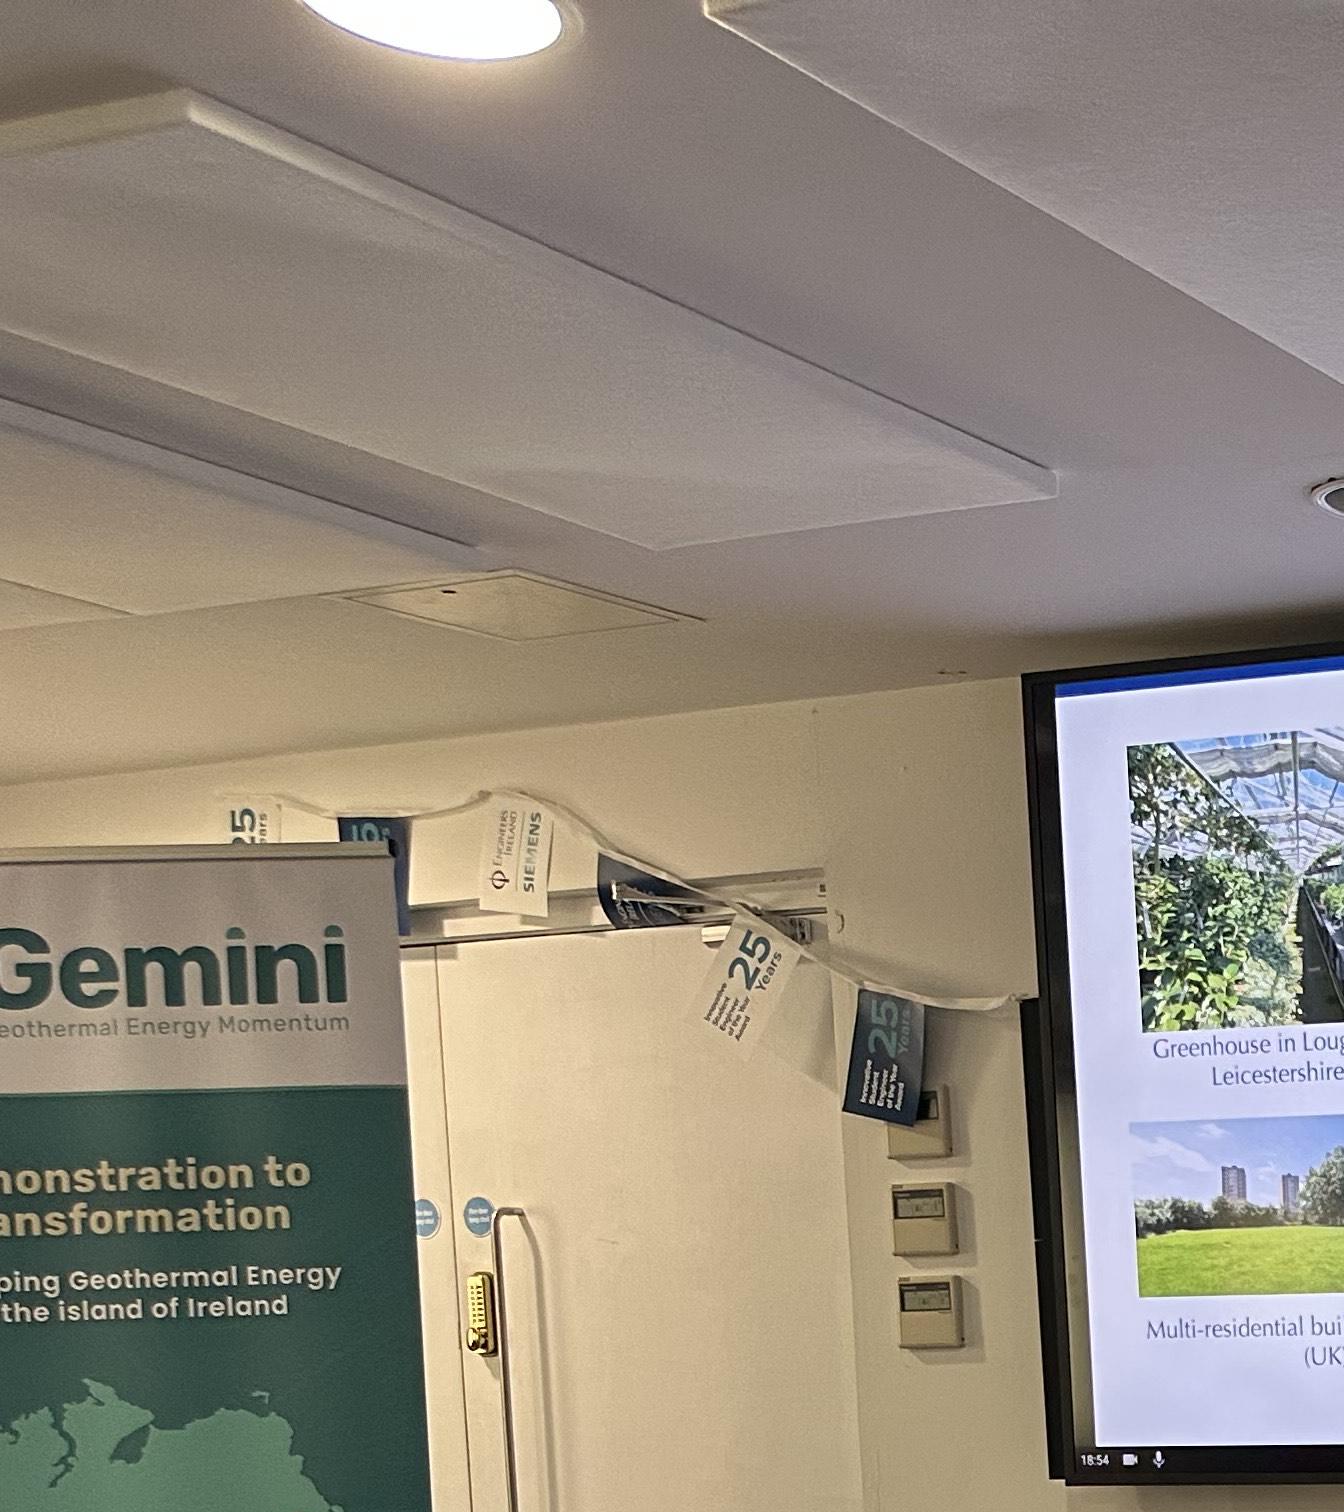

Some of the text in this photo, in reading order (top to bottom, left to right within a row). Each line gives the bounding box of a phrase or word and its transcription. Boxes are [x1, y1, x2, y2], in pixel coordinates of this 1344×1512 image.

[231, 808, 257, 844] 5
[523, 812, 542, 893] SIEMENS
[0, 925, 348, 1010] Gemini
[728, 929, 771, 991] 25
[755, 951, 782, 990] Years
[127, 1018, 210, 1039] Energy
[219, 1015, 349, 1034] Momentum
[868, 999, 899, 1058] 25
[1153, 1034, 1271, 1059] Greenhouse
[1278, 1031, 1296, 1052] in
[1212, 1061, 1344, 1086] Leicestershire
[263, 1155, 311, 1188] to
[69, 1265, 238, 1291] Geothermal
[247, 1265, 342, 1290] Energy
[1, 1294, 288, 1323] the island of Ireland
[1146, 1315, 1303, 1339] Multi-residential
